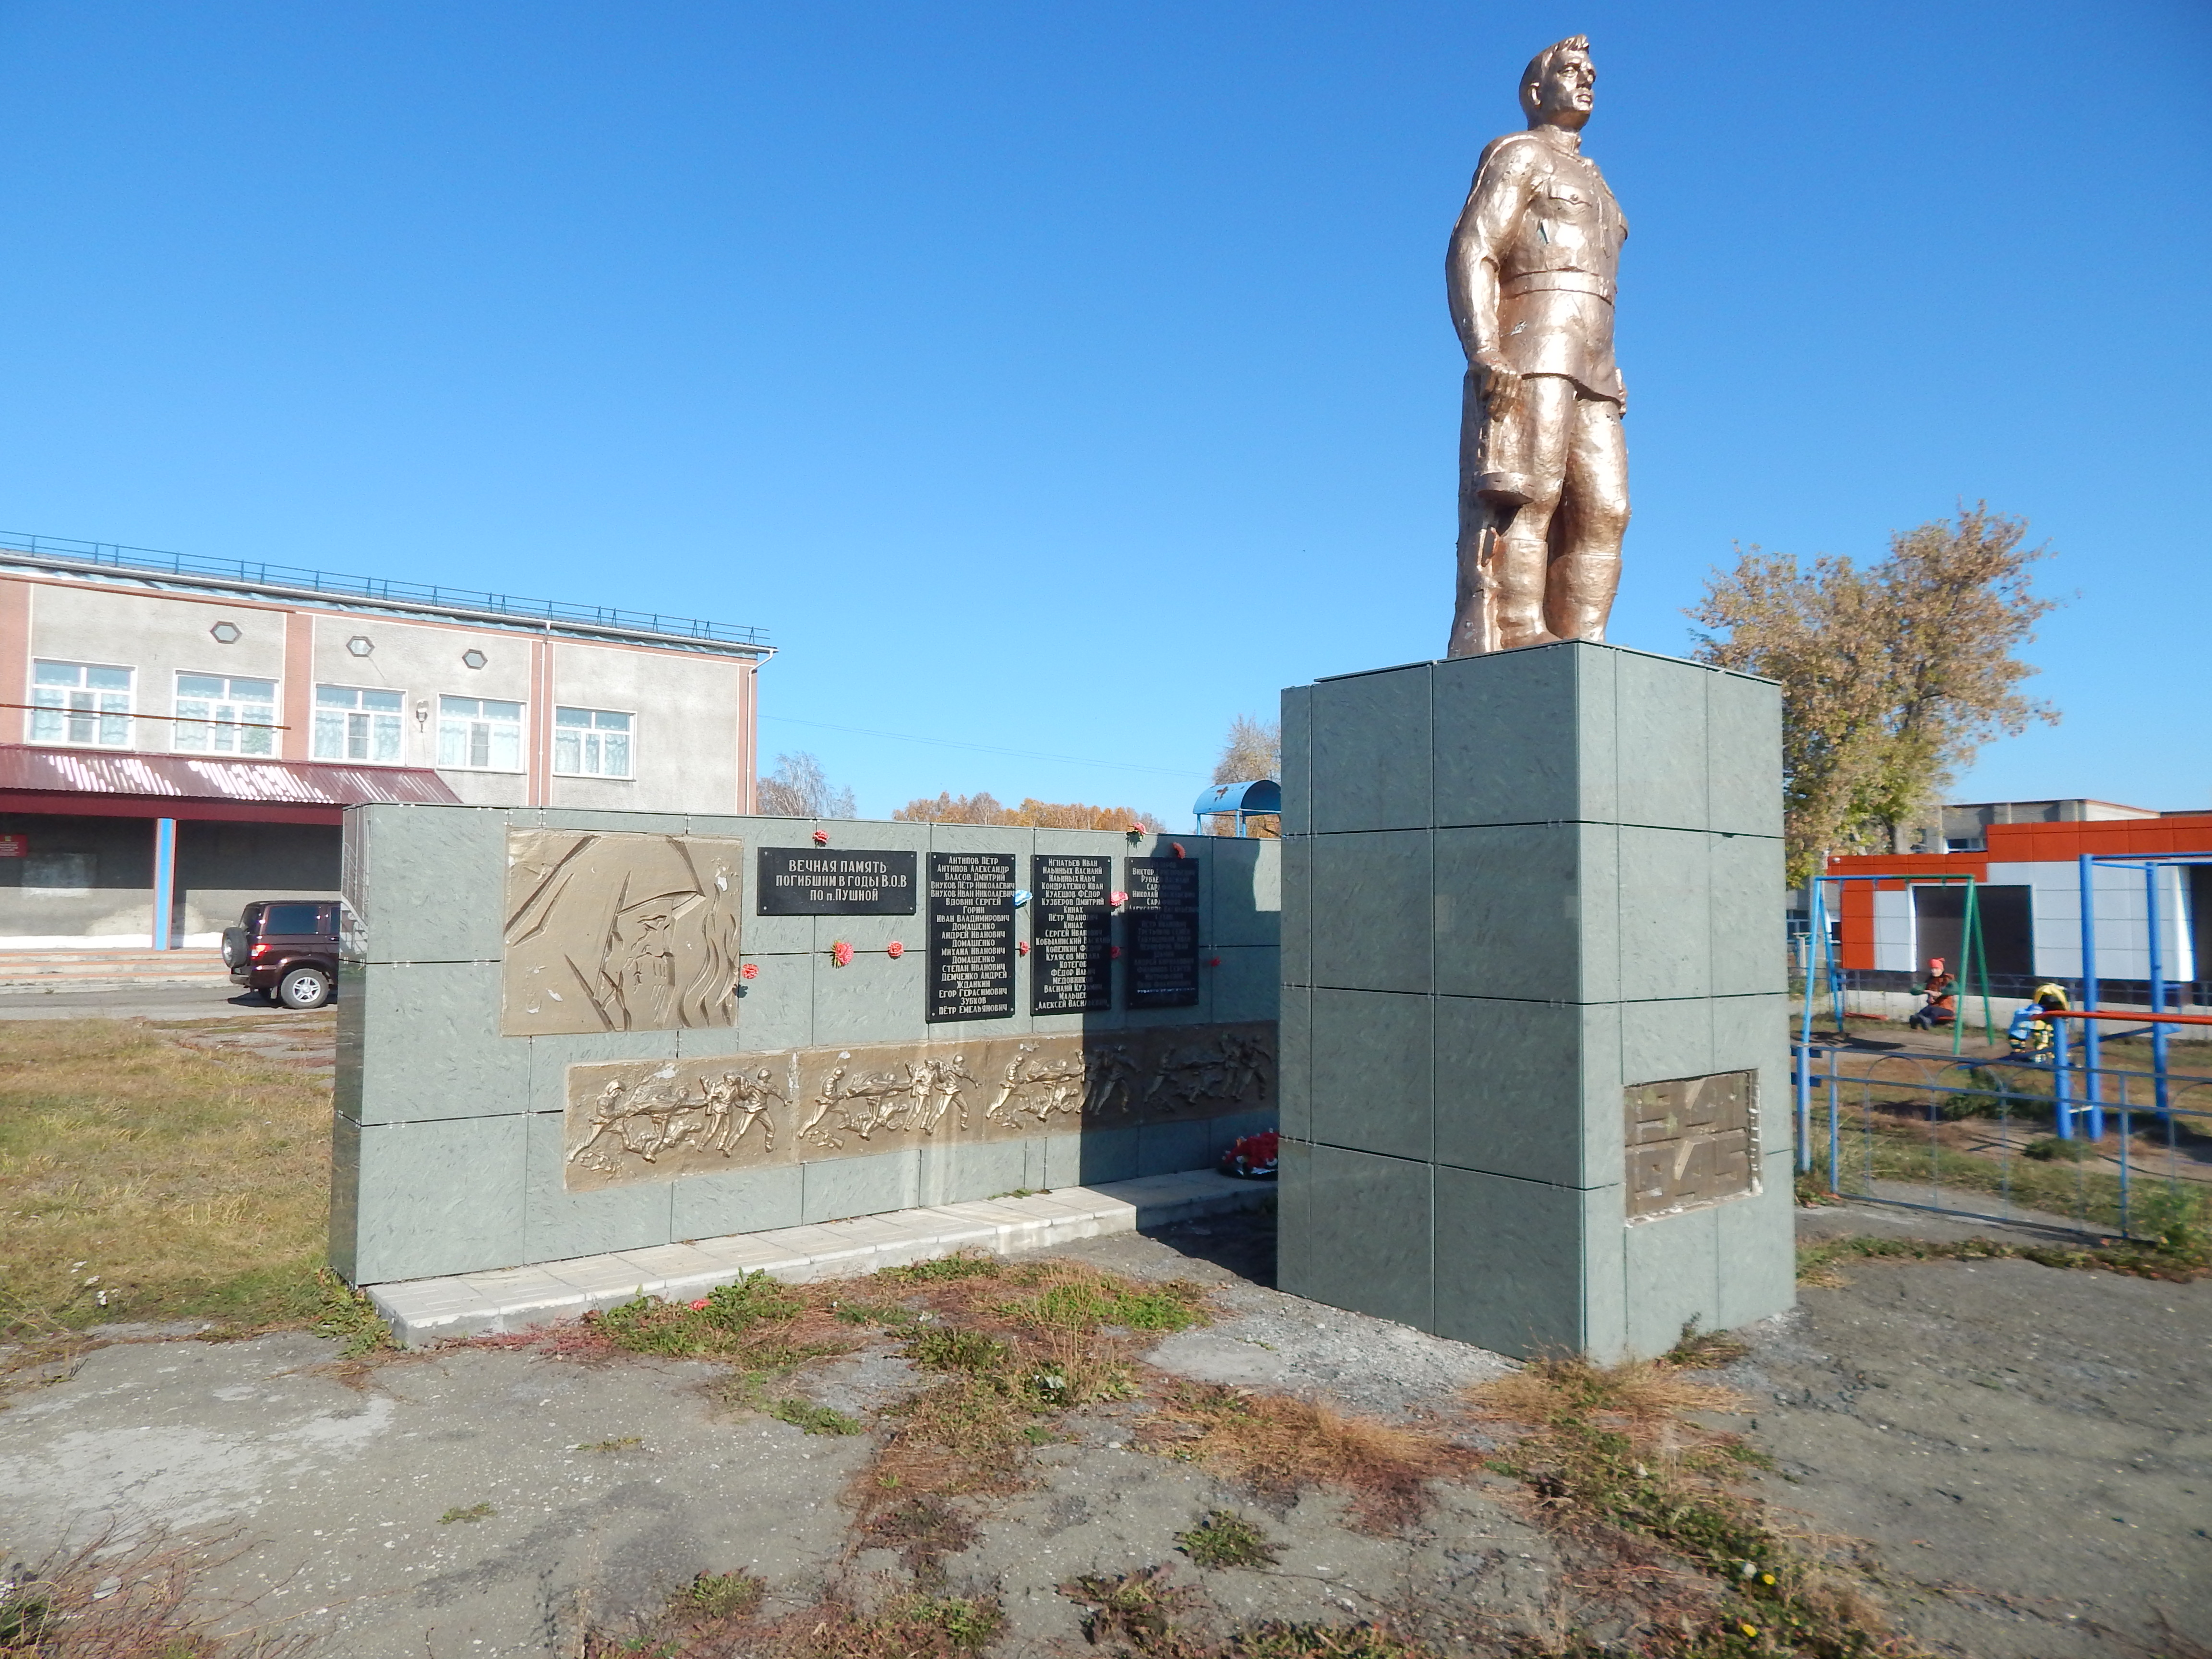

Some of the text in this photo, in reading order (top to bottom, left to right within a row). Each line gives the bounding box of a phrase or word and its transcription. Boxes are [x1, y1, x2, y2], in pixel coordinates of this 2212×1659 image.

[789, 860, 887, 873] ВЕЧНАЯ ПАМЯТЬ
[776, 875, 907, 888] ПОГИБШИМ В ГОДЫ В.О.В
[810, 890, 823, 901] ПО
